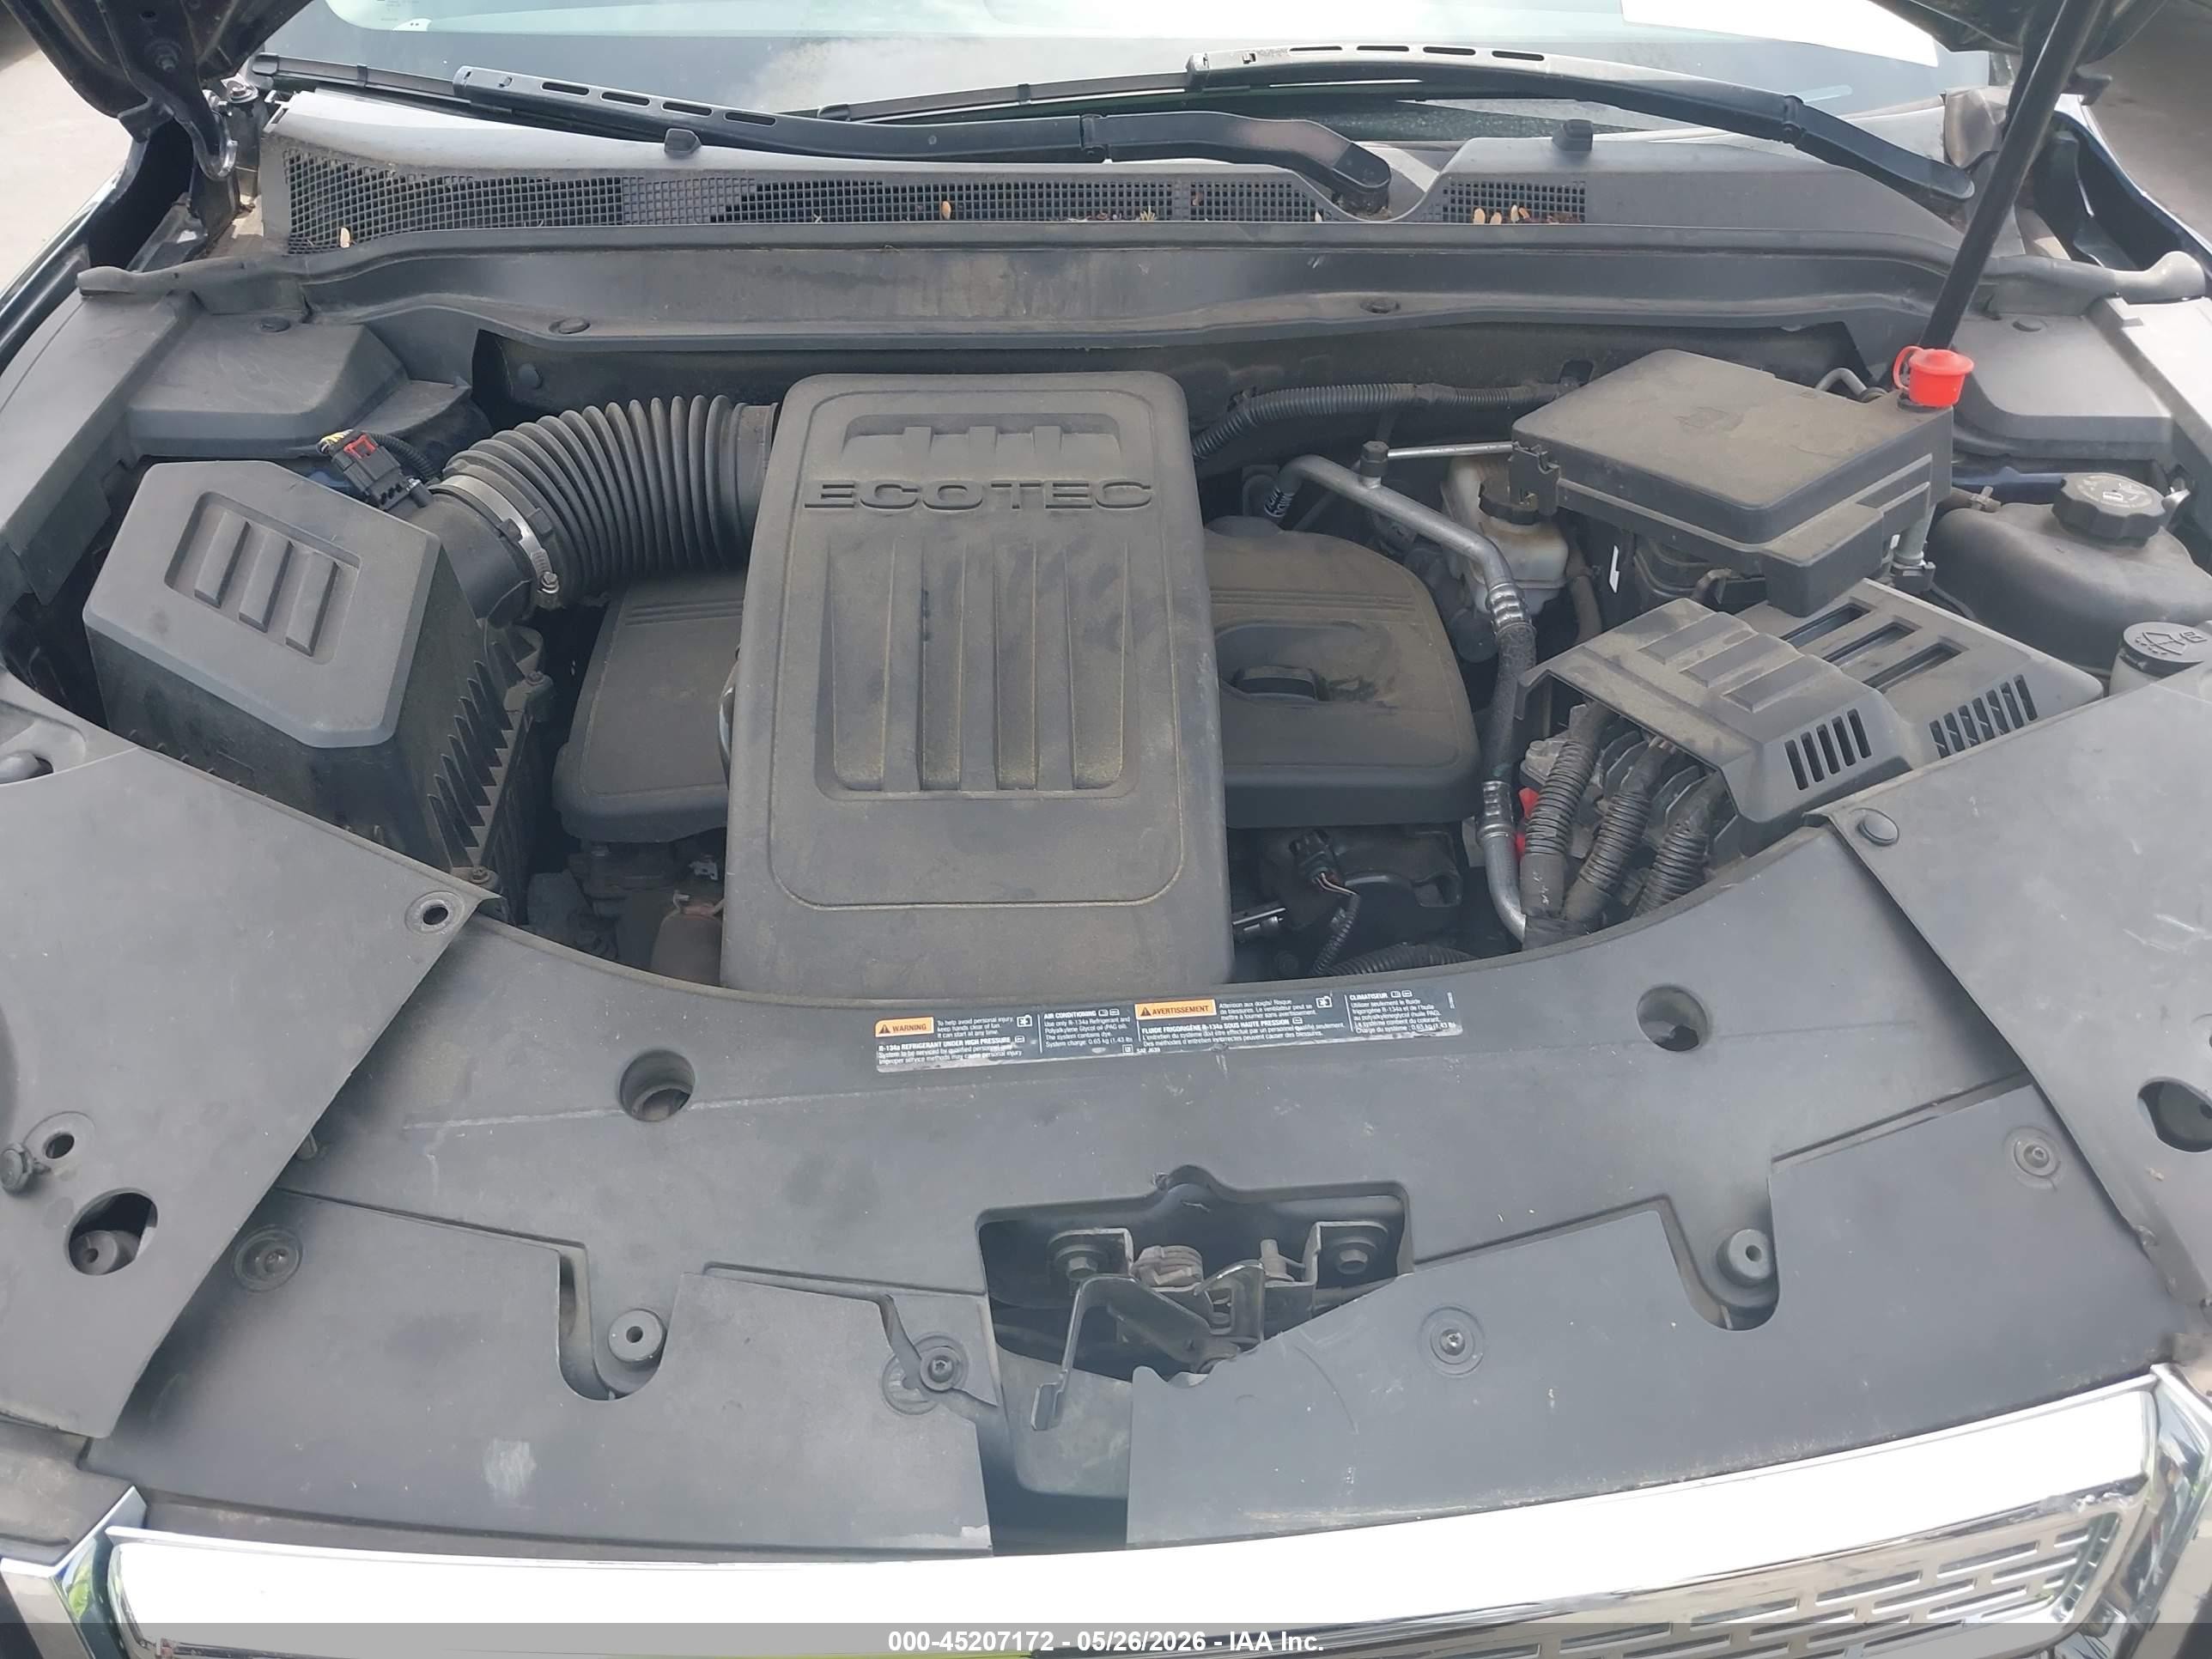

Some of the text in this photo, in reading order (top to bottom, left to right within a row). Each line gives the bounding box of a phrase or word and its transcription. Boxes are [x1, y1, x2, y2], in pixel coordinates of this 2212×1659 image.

[804, 480, 1152, 510] ECOTEC
[1152, 1006, 1209, 1016] AVERTISSEMENT
[892, 1024, 927, 1032] WARNING
[902, 1042, 941, 1050] REFRIGERANT
